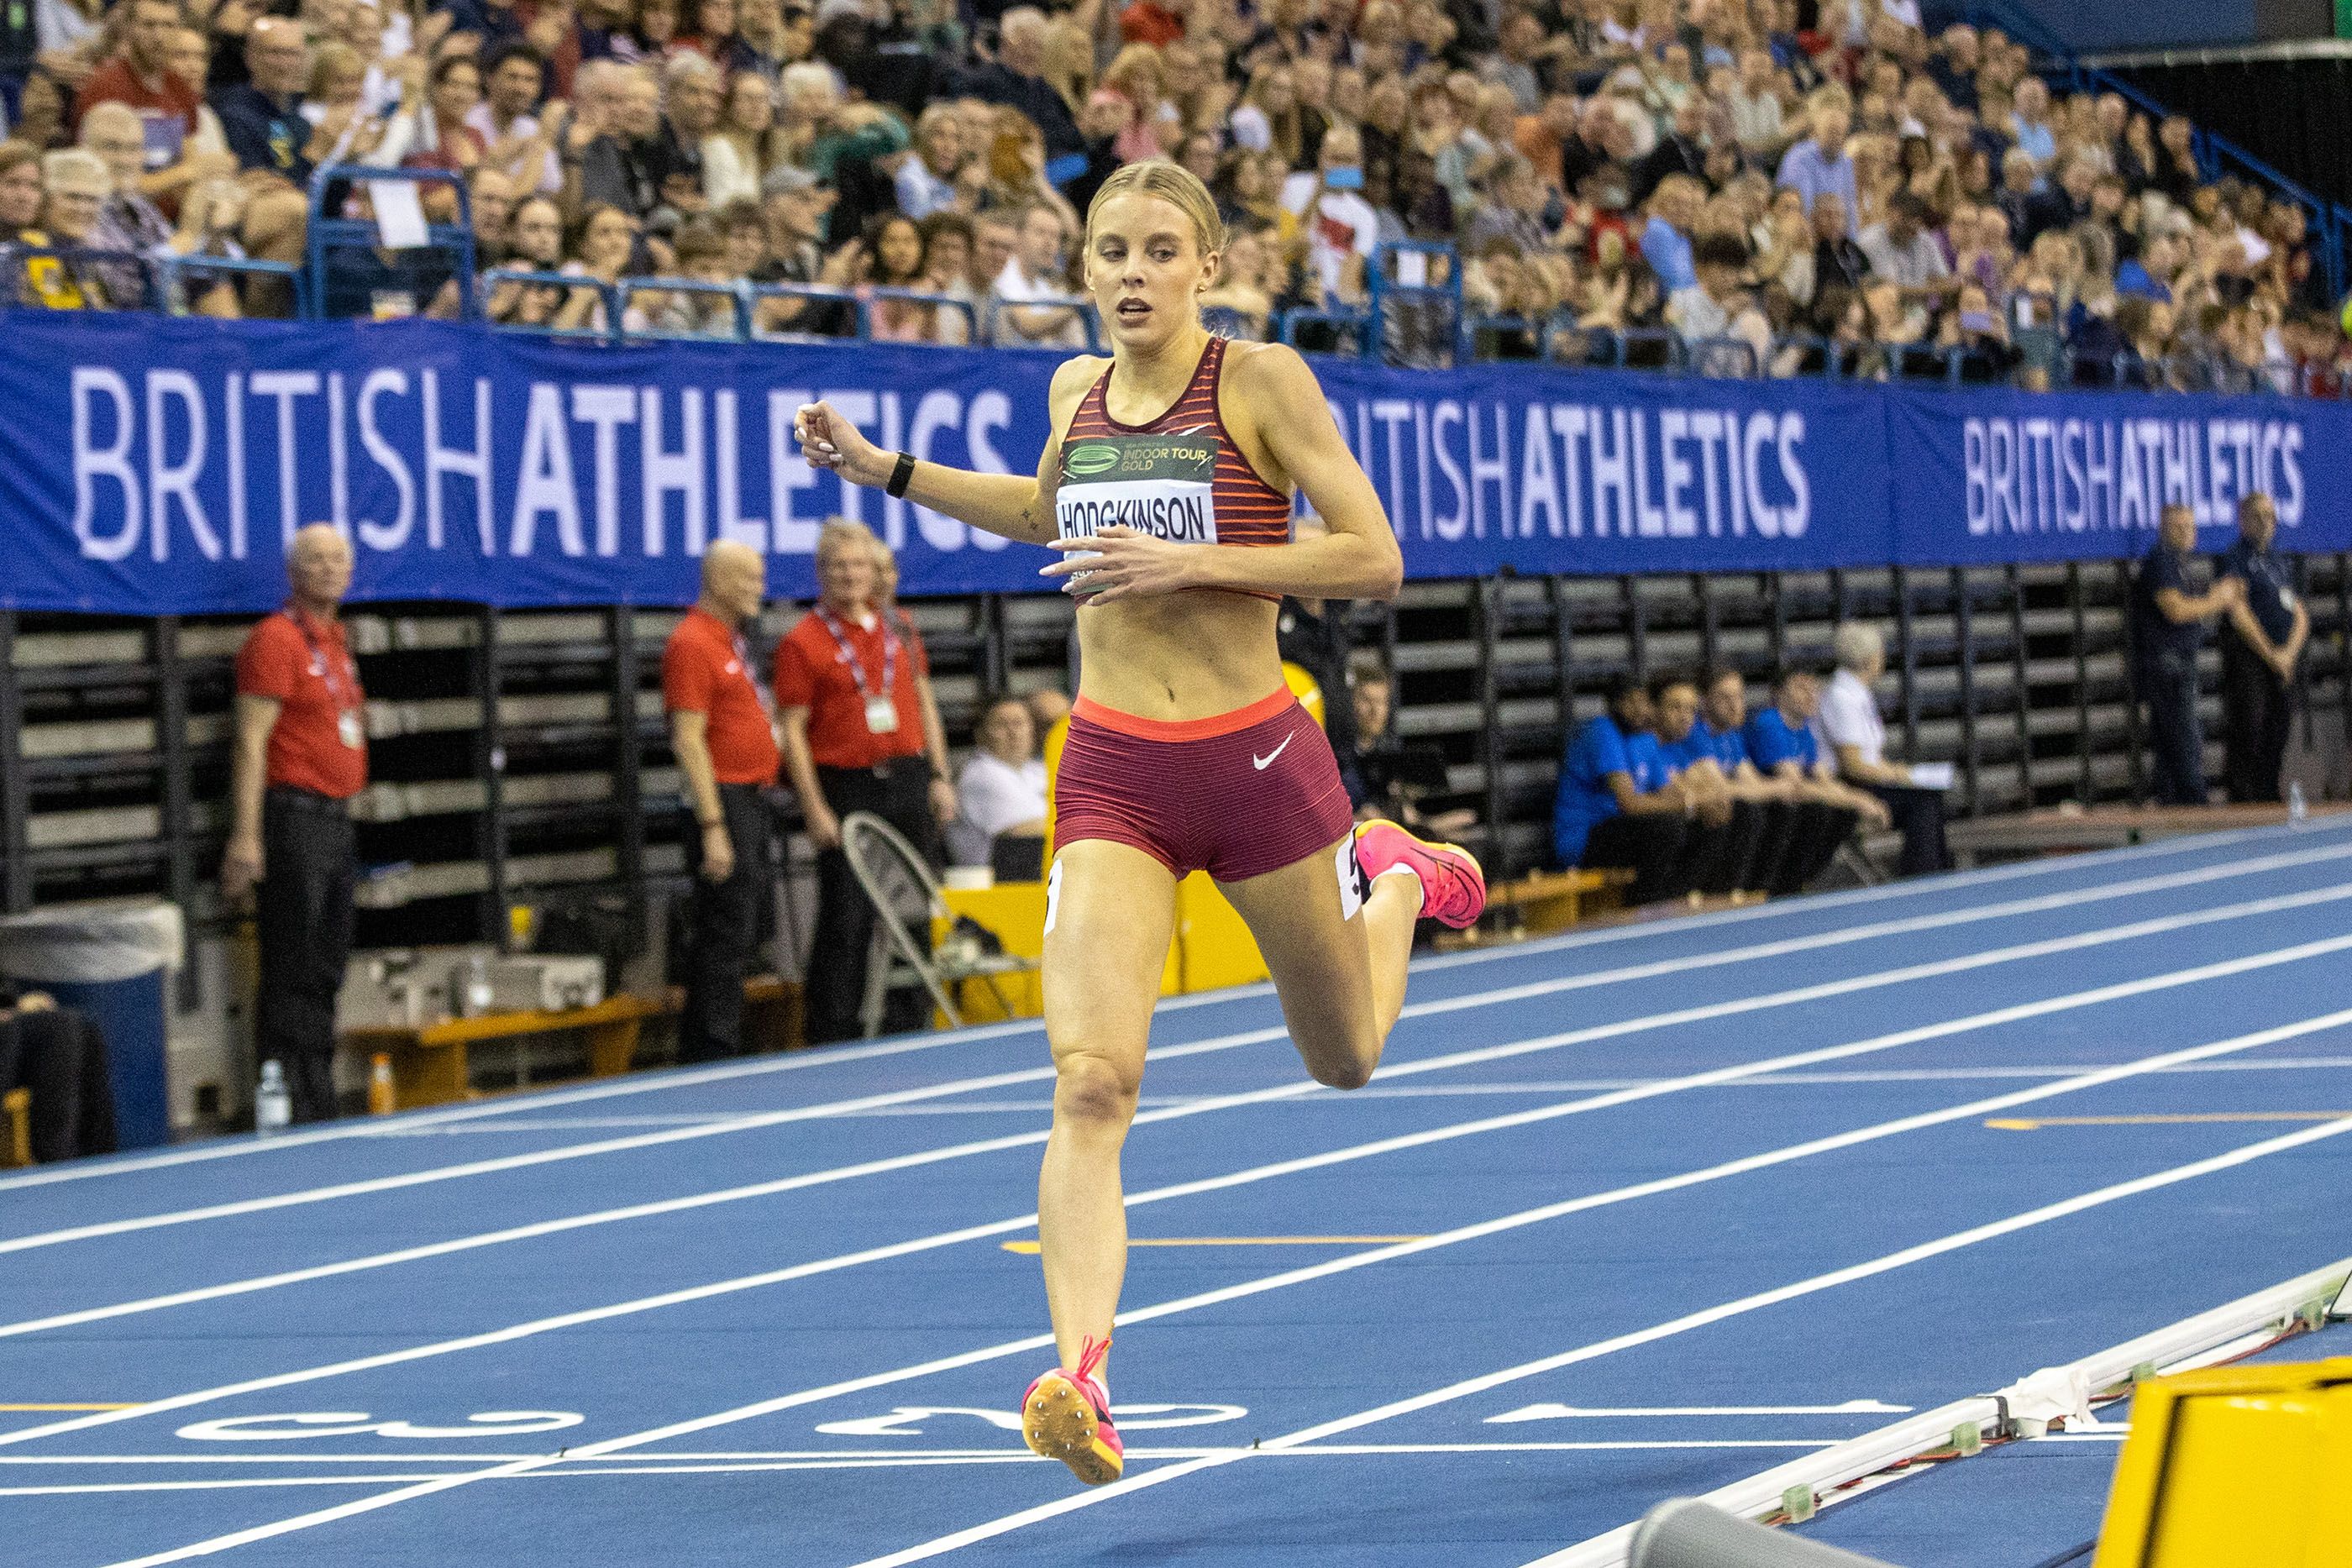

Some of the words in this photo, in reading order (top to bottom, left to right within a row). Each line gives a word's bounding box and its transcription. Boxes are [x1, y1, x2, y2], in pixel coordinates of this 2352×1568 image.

[72, 366, 496, 562] BRITISH
[1121, 460, 1153, 472] GOLD
[1124, 448, 1169, 460] INDOOR
[1171, 447, 1207, 461] TOUR
[1518, 402, 1811, 539] ATHLETICS
[1963, 417, 2118, 536] BRITISH
[1062, 496, 1205, 540] HODGKINSON
